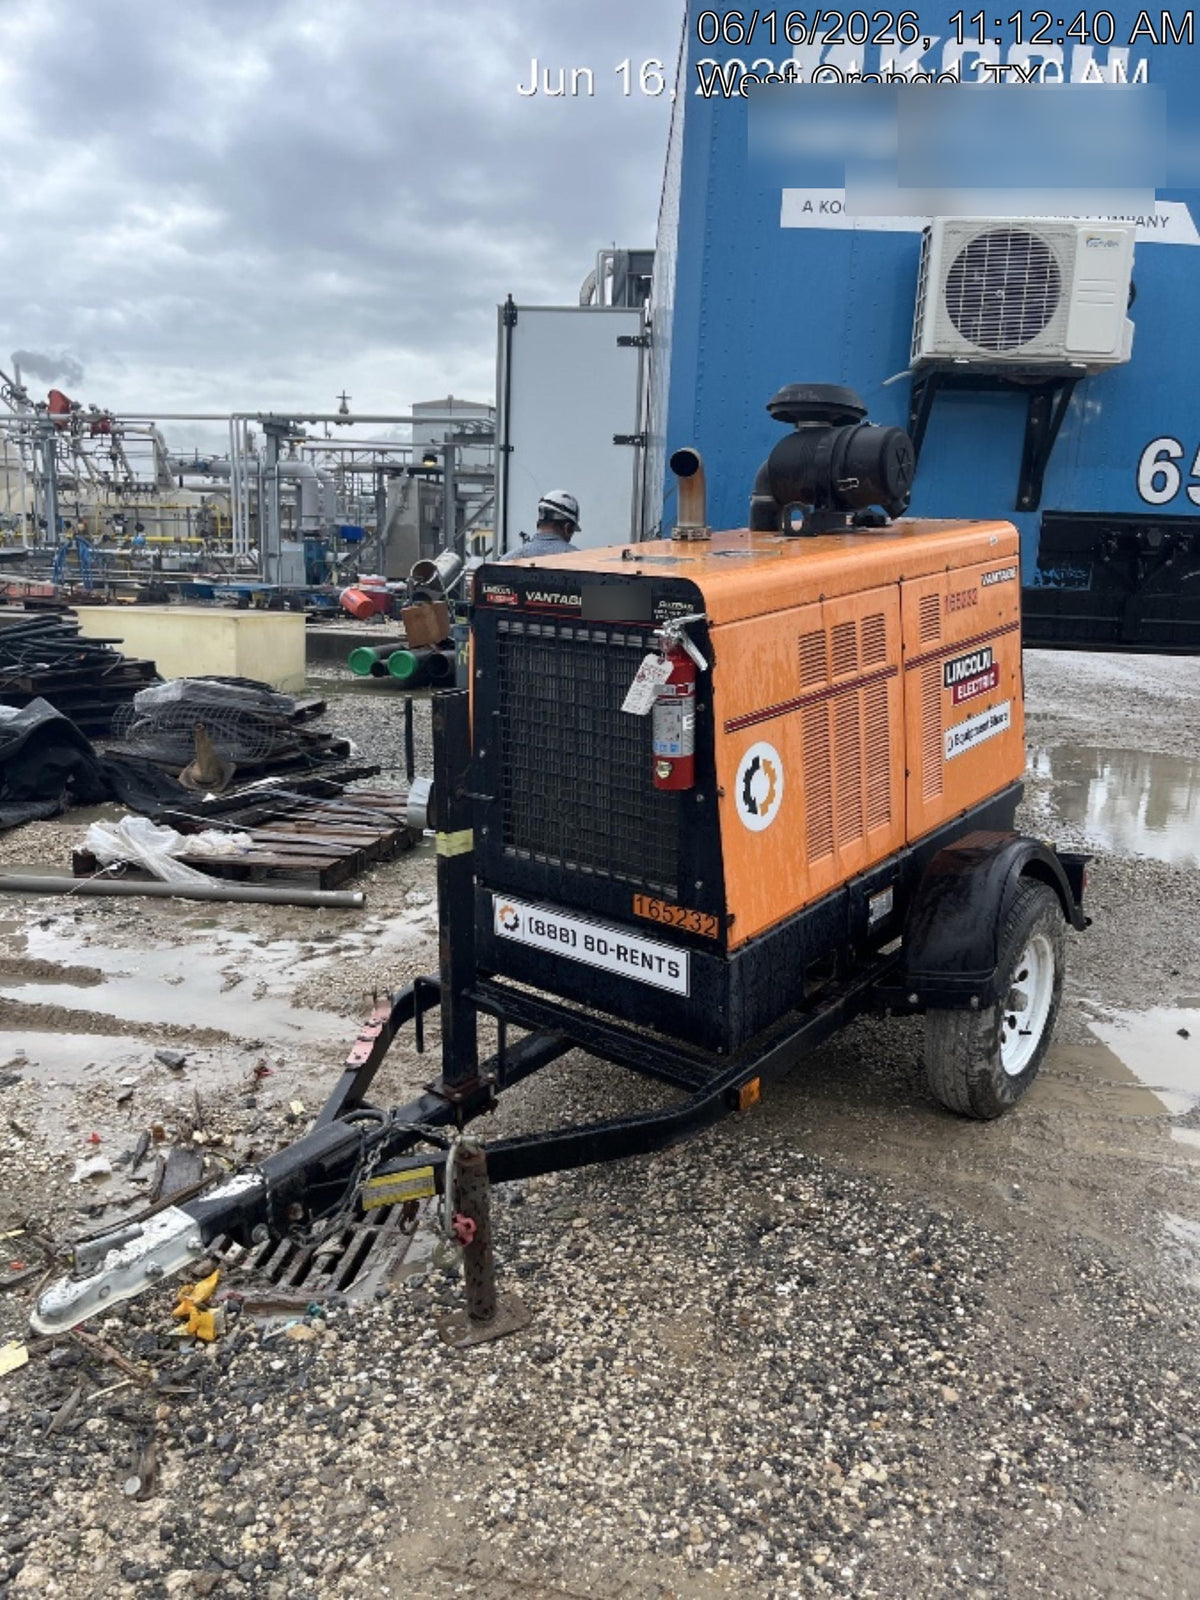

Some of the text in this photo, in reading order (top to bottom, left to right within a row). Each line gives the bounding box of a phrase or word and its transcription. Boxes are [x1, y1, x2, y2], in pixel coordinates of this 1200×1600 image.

[802, 200, 846, 214] A KO
[525, 590, 582, 607] VANTAG
[946, 649, 991, 684] LINCOLN
[957, 671, 995, 700] ELECTRIC
[637, 898, 717, 938] 165232
[528, 917, 681, 979] (888) 80-RENTS
